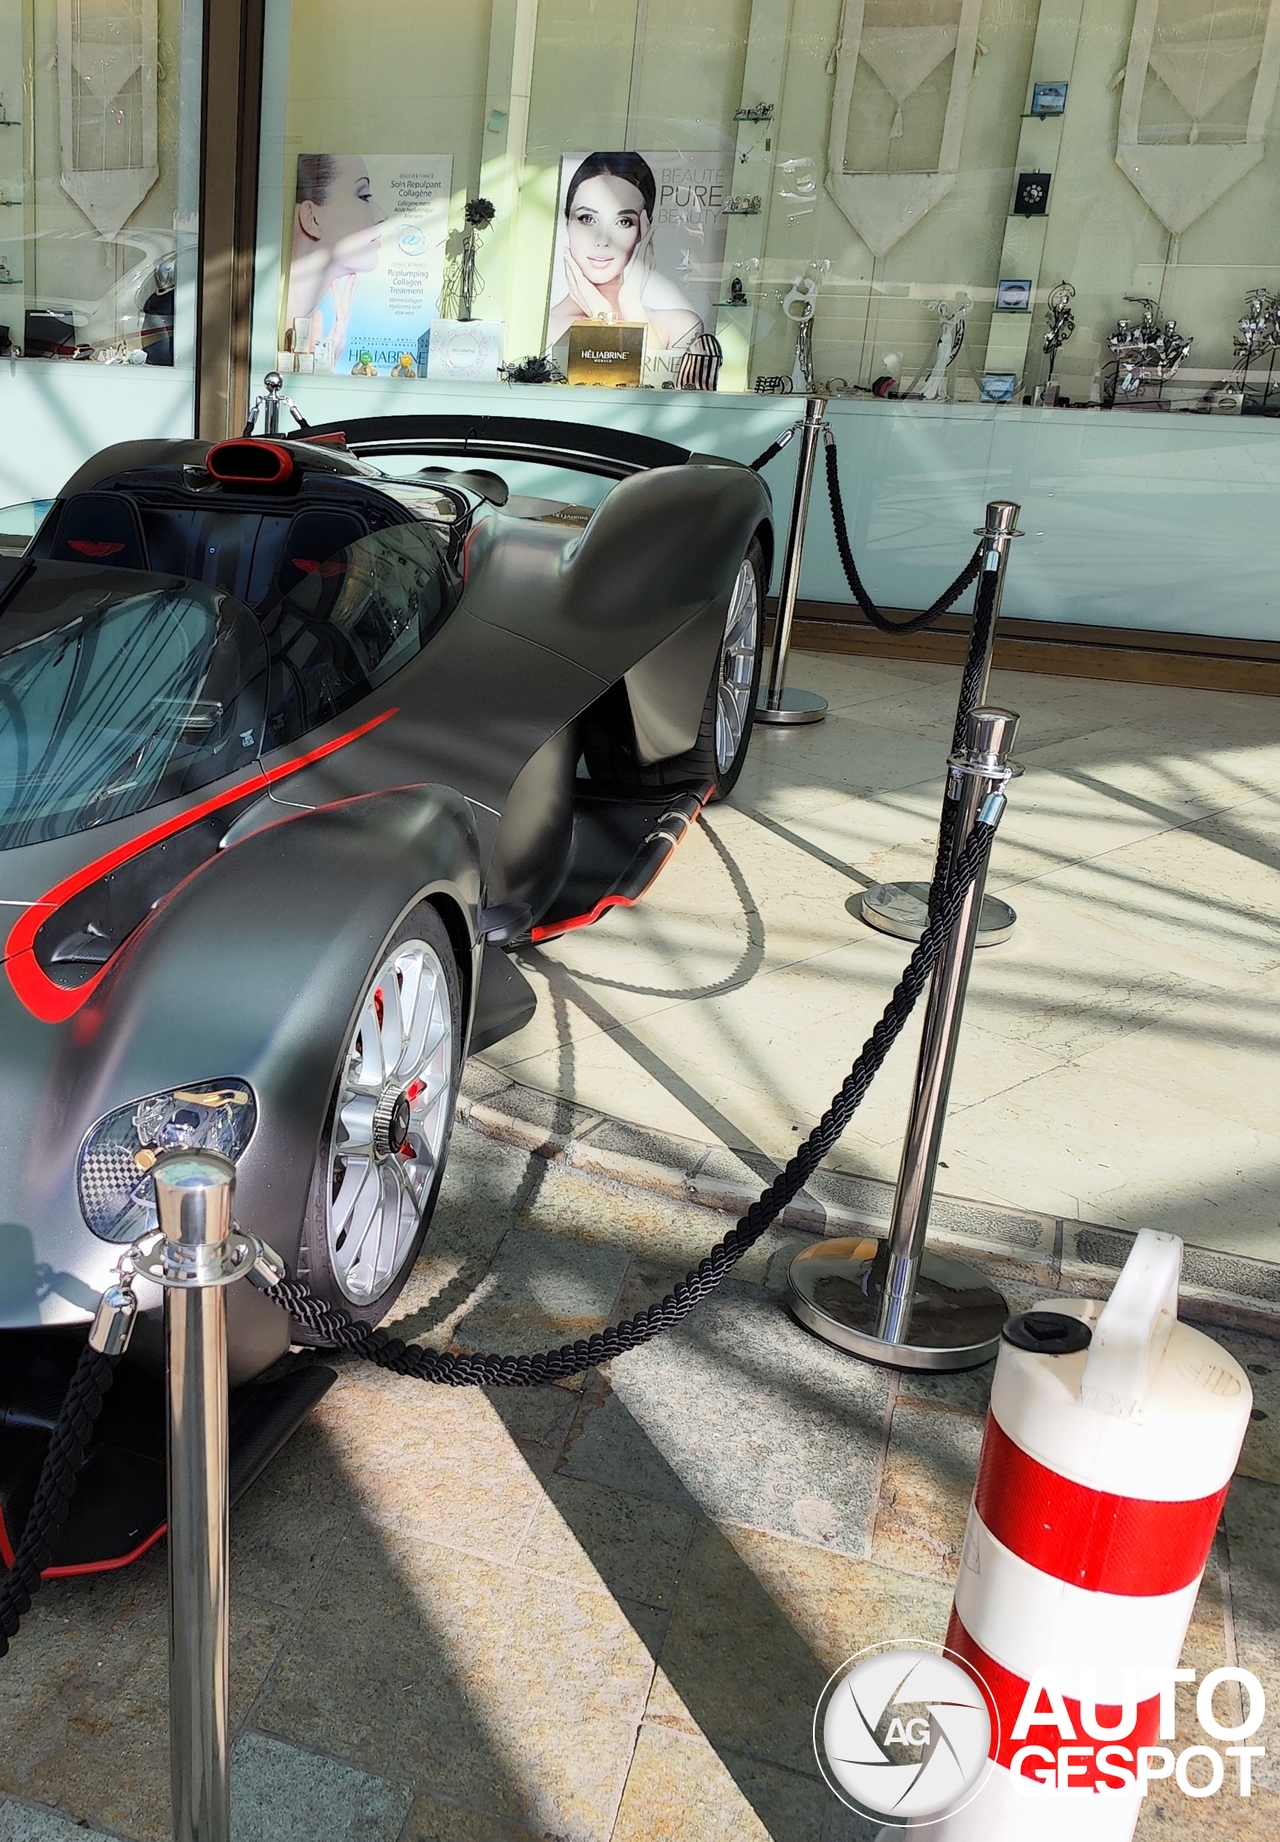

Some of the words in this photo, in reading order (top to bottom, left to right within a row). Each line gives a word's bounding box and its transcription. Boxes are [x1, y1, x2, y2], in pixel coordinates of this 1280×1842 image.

[661, 165, 725, 184] BEAUTÉ
[390, 180, 406, 188] Soin
[407, 180, 442, 190] Repulpant
[398, 189, 432, 199] Collagène
[660, 185, 723, 207] PURE
[658, 208, 720, 224] BEAUTY
[387, 269, 429, 280] Replumping
[392, 278, 422, 288] Collagen
[389, 286, 424, 295] Treatment
[348, 346, 429, 365] HÉIABRNE
